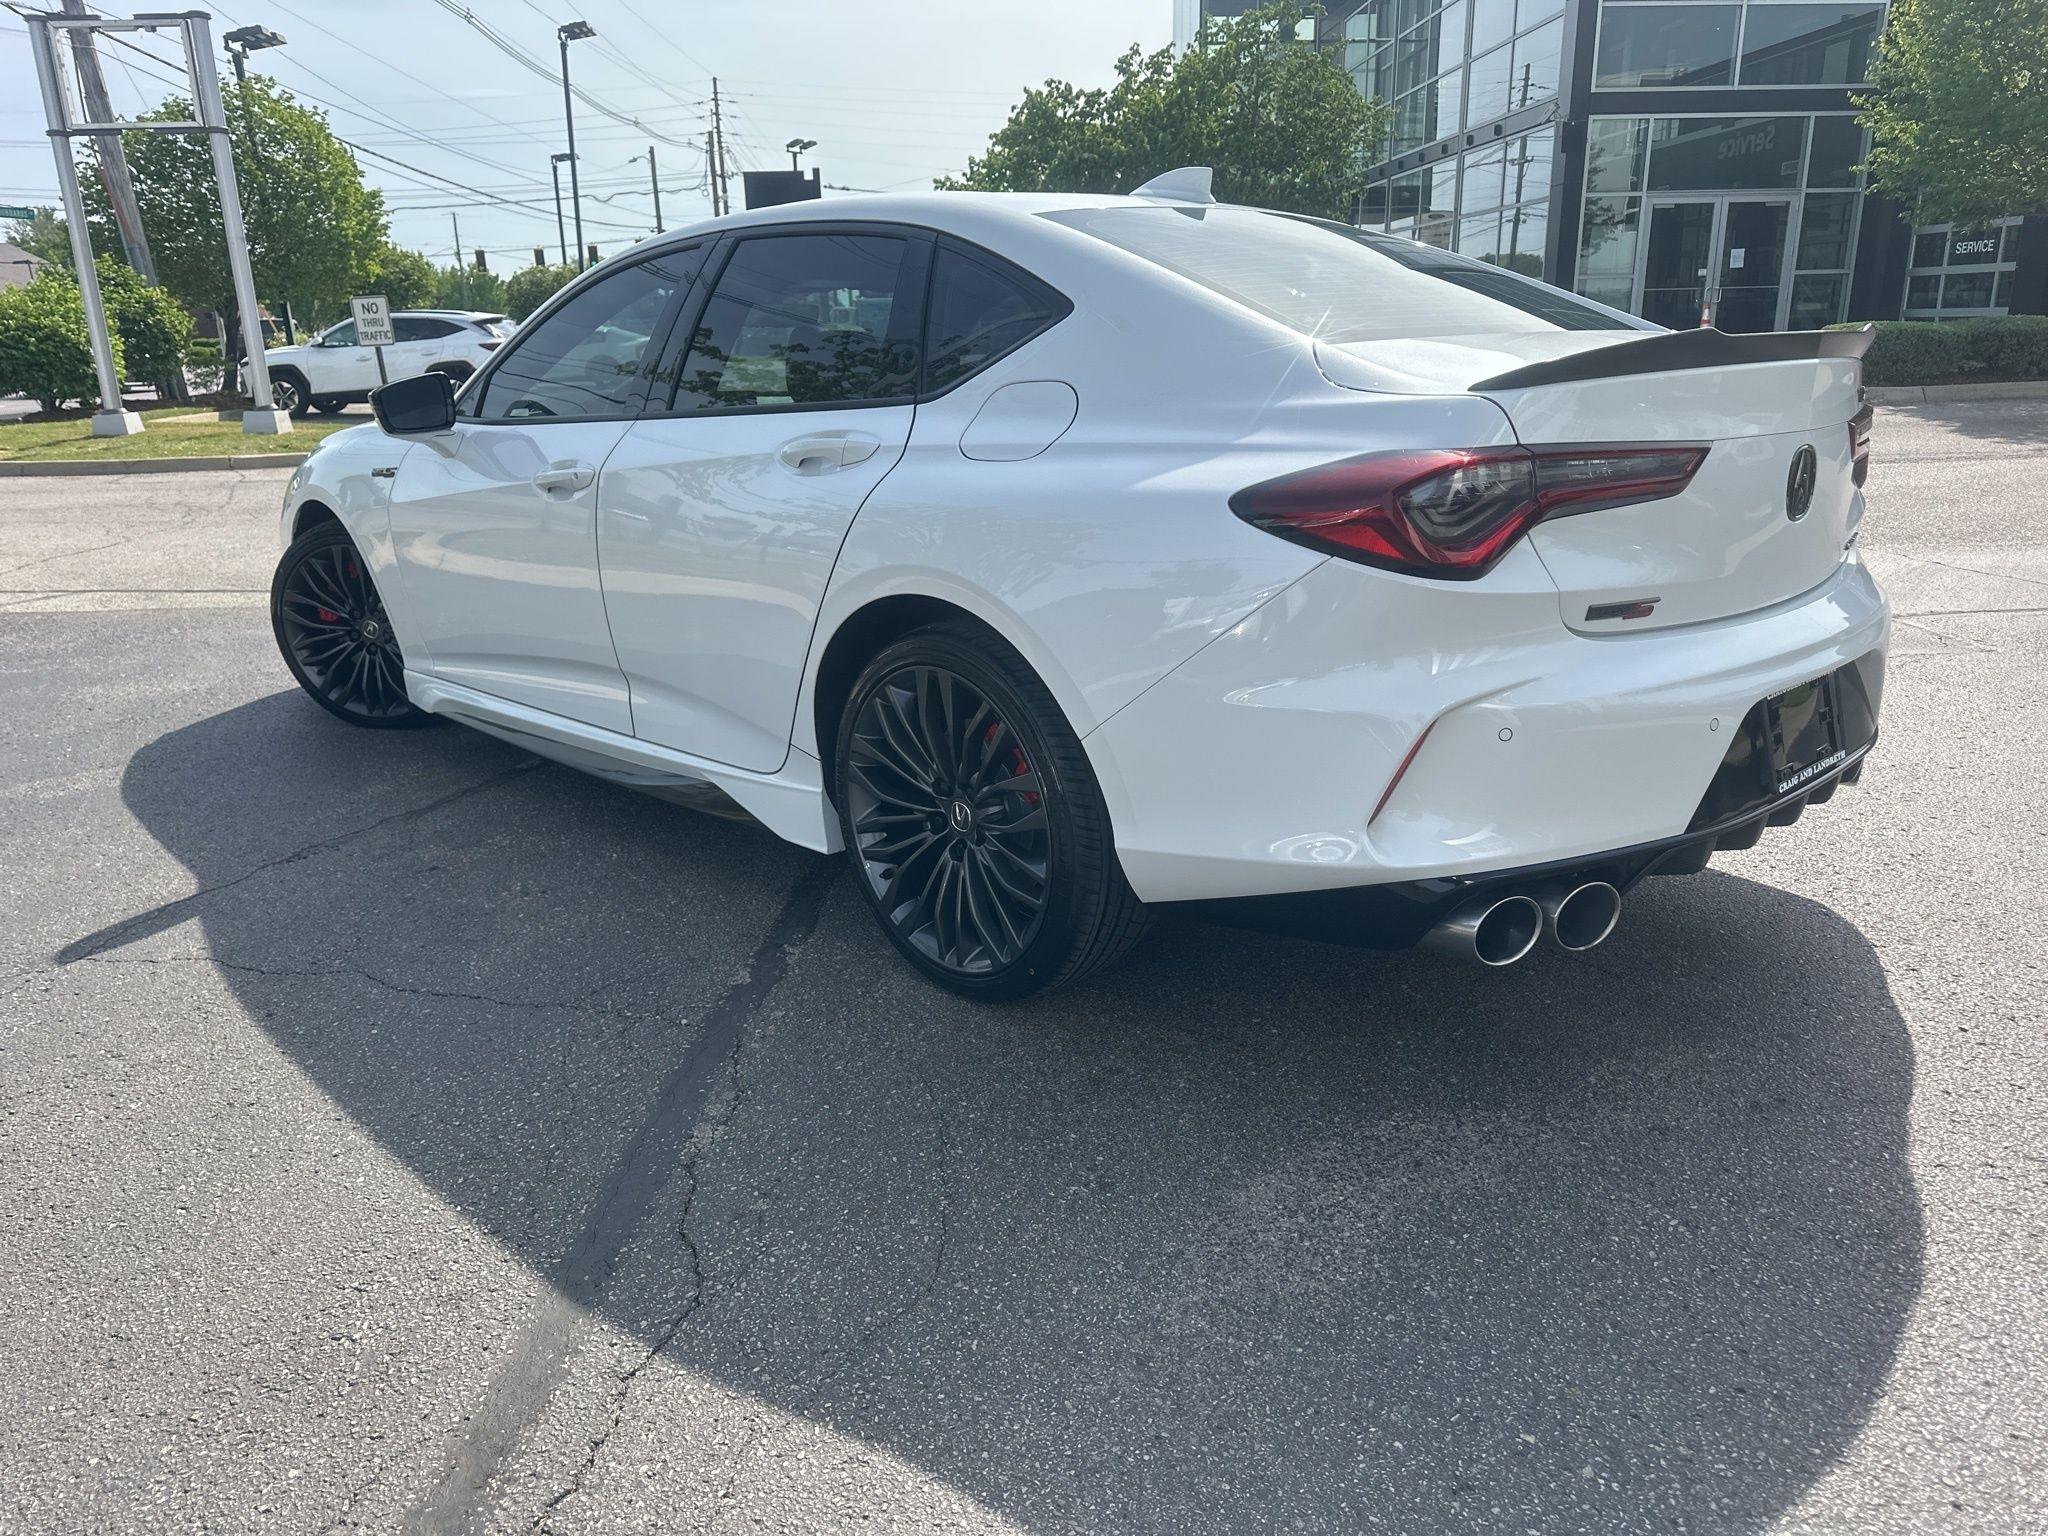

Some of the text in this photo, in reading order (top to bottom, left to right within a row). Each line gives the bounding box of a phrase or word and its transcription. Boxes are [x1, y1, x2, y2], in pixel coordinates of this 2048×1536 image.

[1955, 239, 1995, 254] SERVICE
[361, 302, 379, 314] NO
[362, 317, 384, 327] THRU
[360, 330, 391, 341] TRAFFIC
[1779, 776, 1799, 793] CRAIG
[1799, 768, 1813, 782] AND
